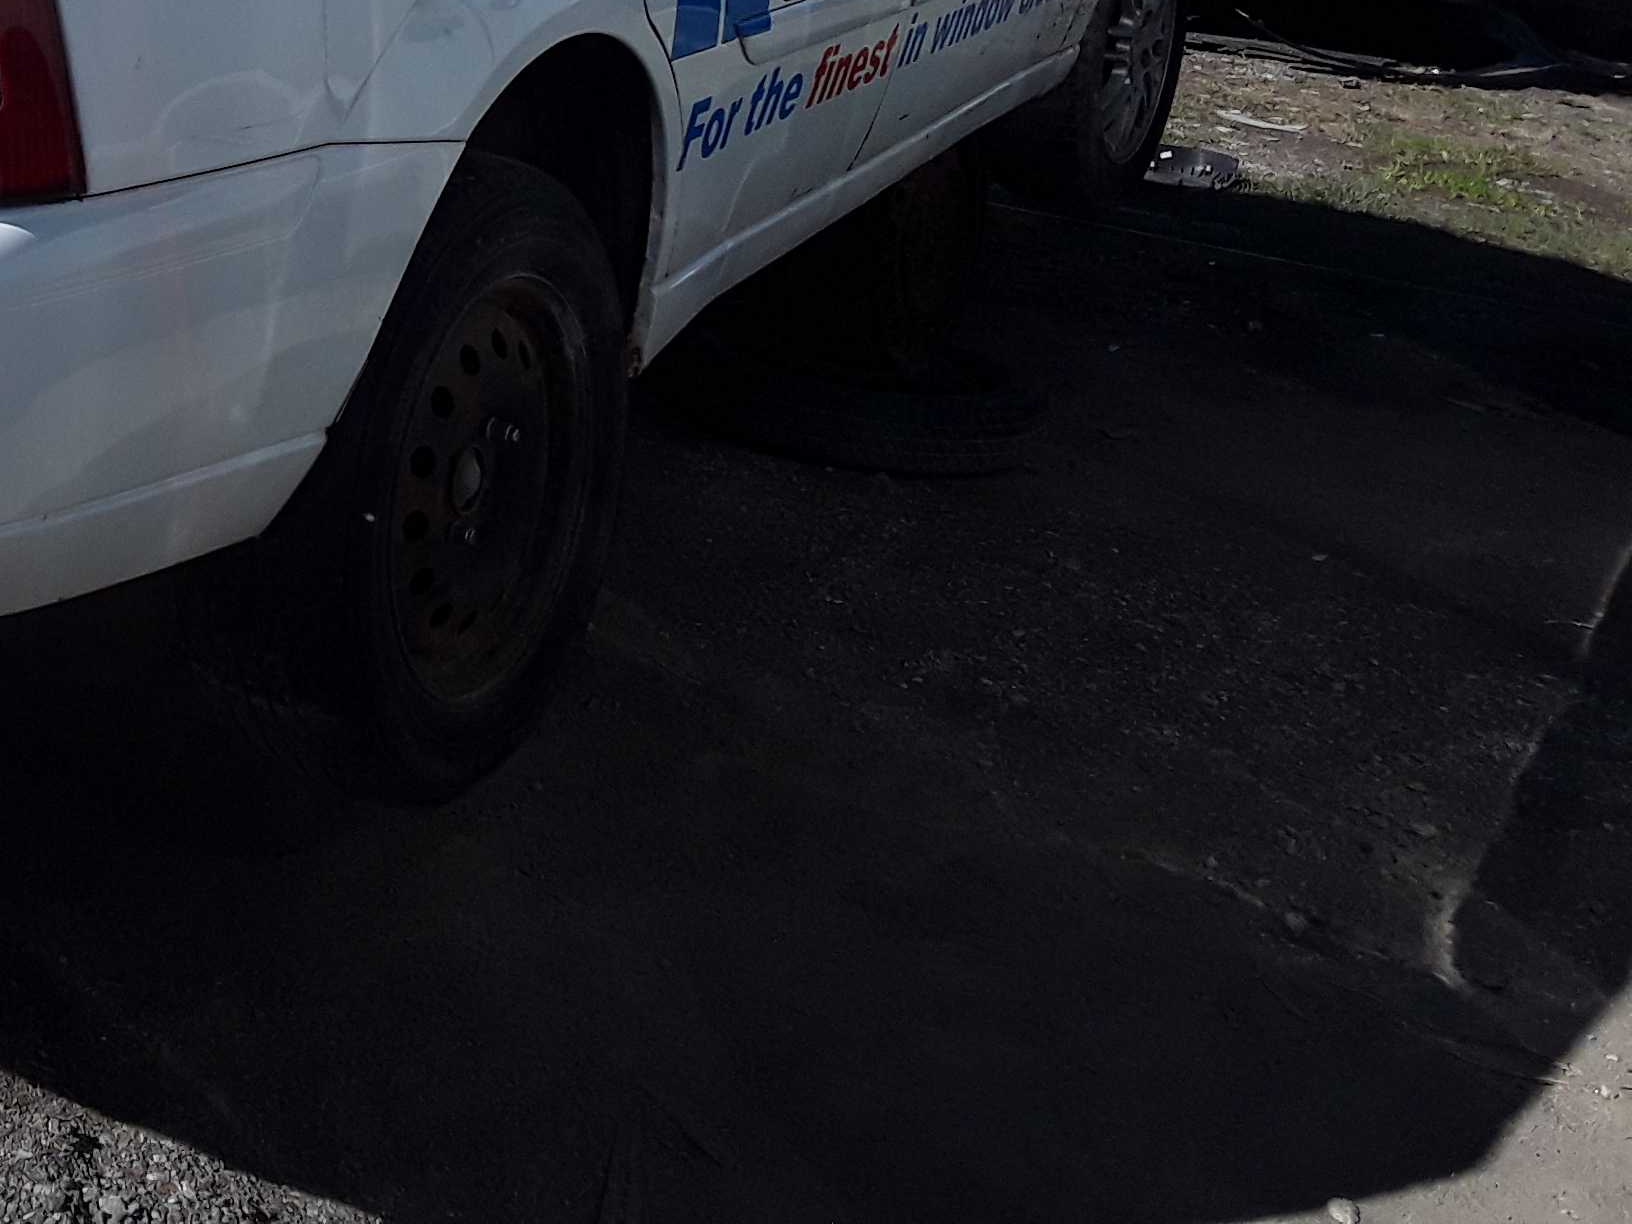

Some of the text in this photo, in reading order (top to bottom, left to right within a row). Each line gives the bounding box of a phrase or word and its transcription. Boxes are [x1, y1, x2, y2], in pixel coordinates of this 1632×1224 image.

[676, 96, 743, 172] For
[744, 66, 804, 137] the
[805, 23, 900, 110] finest
[897, 12, 929, 70] in
